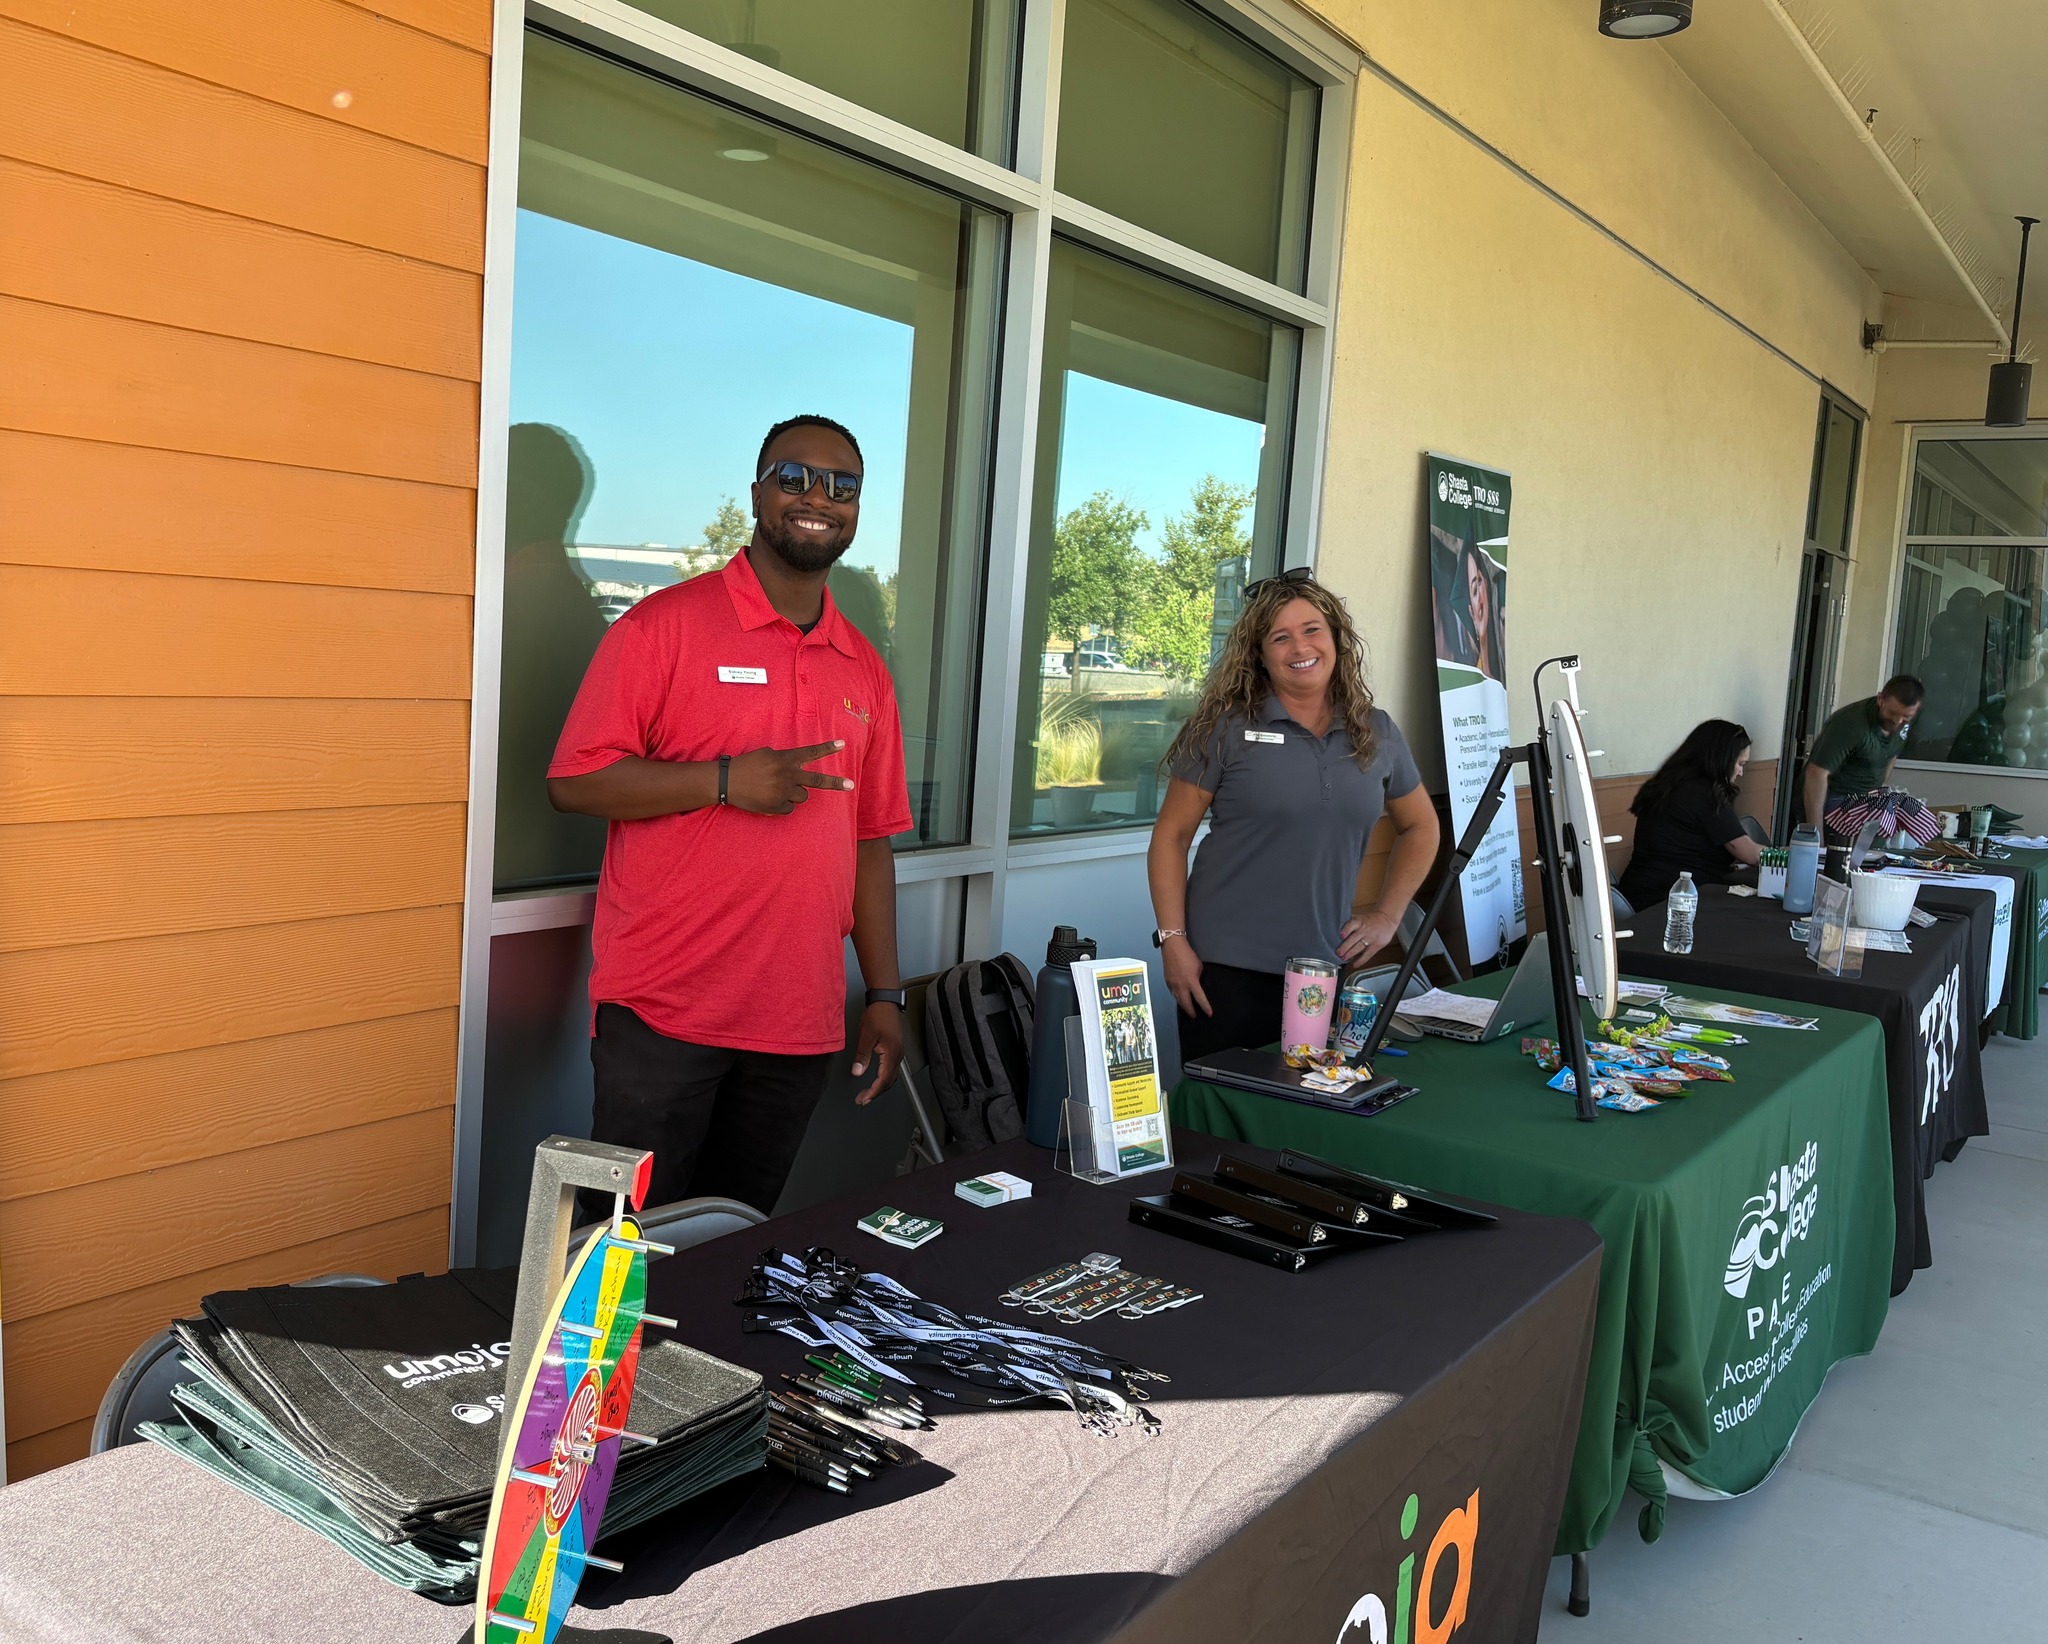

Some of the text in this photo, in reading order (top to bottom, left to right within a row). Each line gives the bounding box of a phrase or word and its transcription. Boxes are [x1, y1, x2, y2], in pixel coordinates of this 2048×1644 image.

[1449, 473, 1469, 491] Shasta
[1449, 488, 1472, 509] College
[1487, 490, 1500, 506] SSS
[1452, 717, 1468, 728] What
[1101, 980, 1141, 1001] umoja
[1103, 996, 1128, 1006] community
[402, 1365, 486, 1389] community
